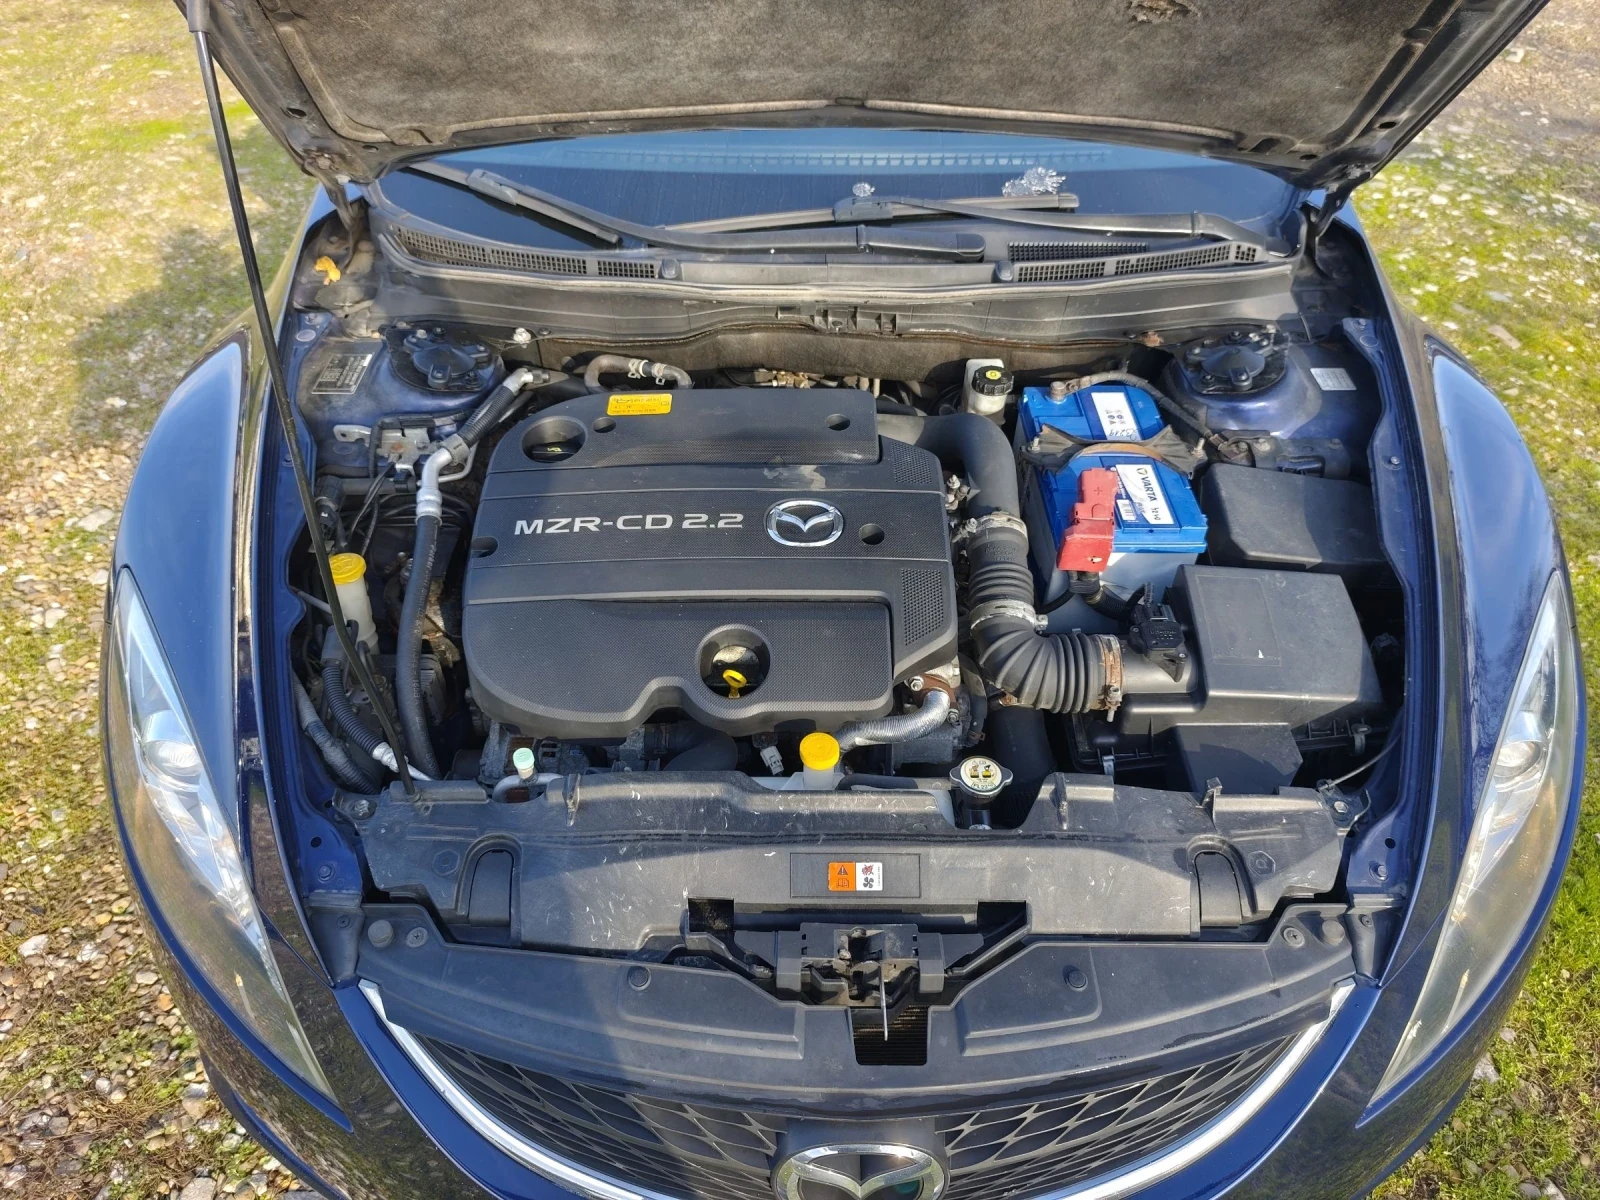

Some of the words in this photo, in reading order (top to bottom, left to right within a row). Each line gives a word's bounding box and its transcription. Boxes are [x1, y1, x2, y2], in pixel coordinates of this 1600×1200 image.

[1141, 476, 1157, 502] VARTA
[514, 514, 673, 535] MZR-CD
[682, 513, 744, 529] 2.2
